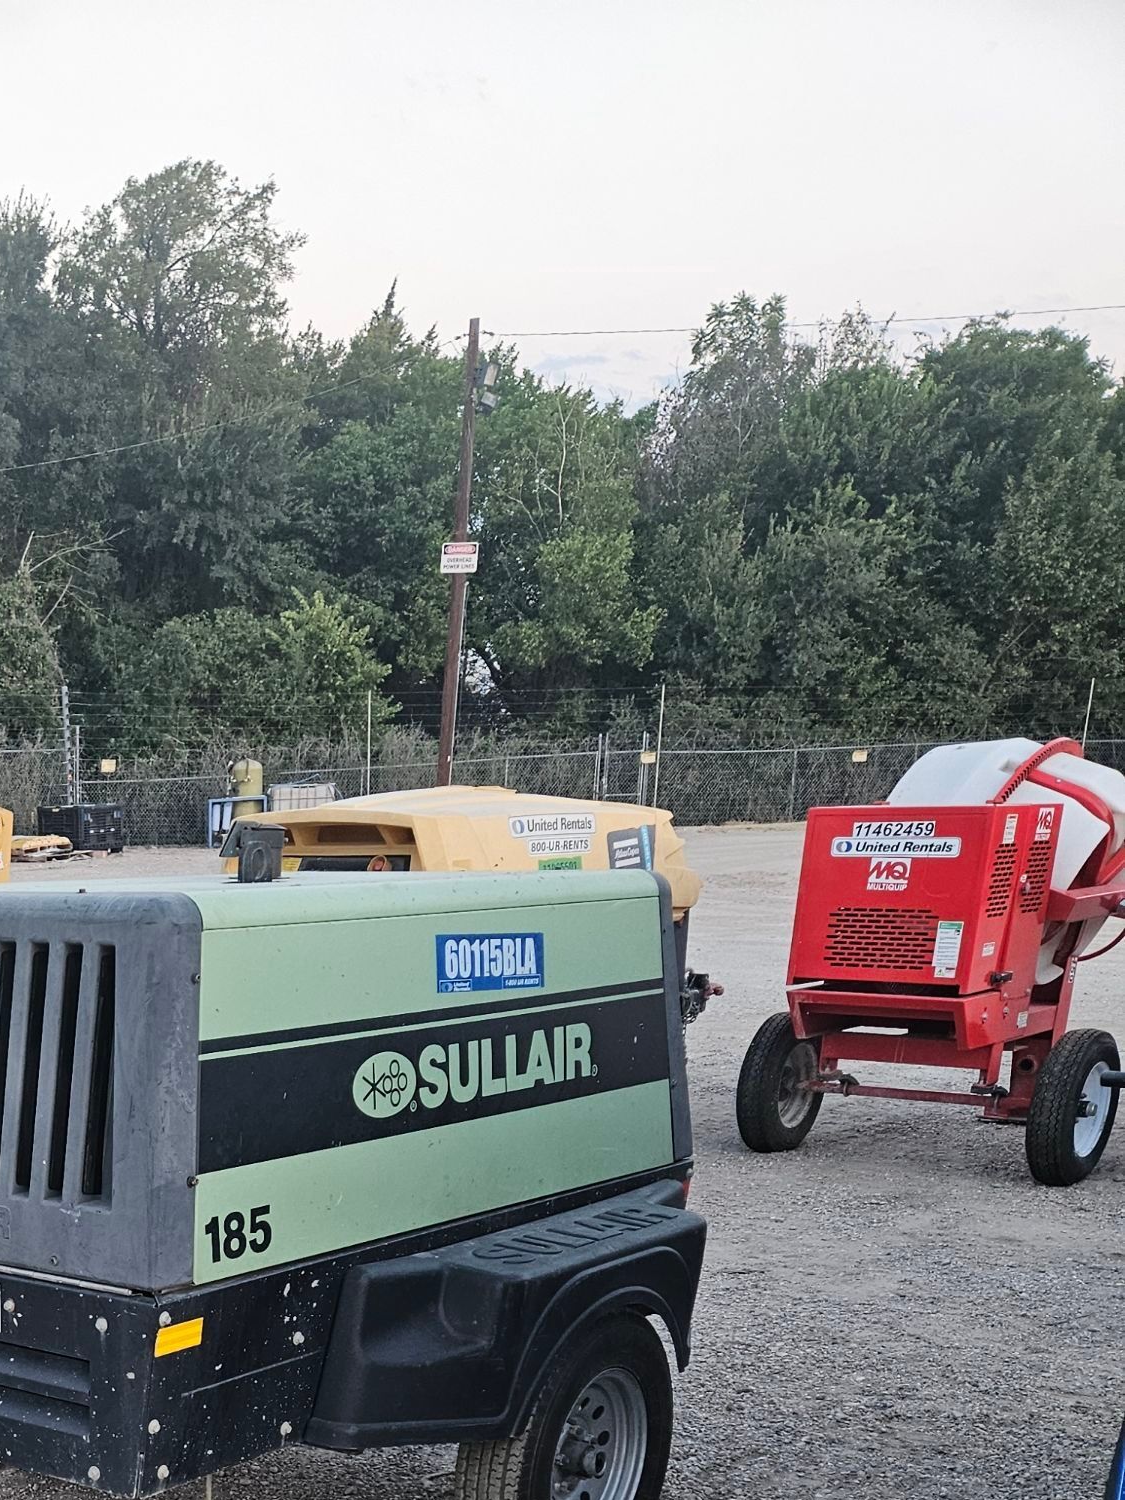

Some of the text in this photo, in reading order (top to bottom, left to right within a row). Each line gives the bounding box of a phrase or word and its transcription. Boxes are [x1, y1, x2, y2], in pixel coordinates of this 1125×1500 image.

[527, 816, 592, 832] United Rentals
[855, 822, 935, 837] 11462459
[531, 839, 589, 852] 800-UR-RENTS
[855, 841, 953, 853] United Rentals
[869, 861, 908, 880] MQ
[867, 882, 908, 891] MULTIQUIP
[444, 937, 537, 979] 60115BLA
[418, 1022, 592, 1109] SULLAIR
[204, 1204, 272, 1264] 185
[472, 1208, 679, 1265] SULLAIR
